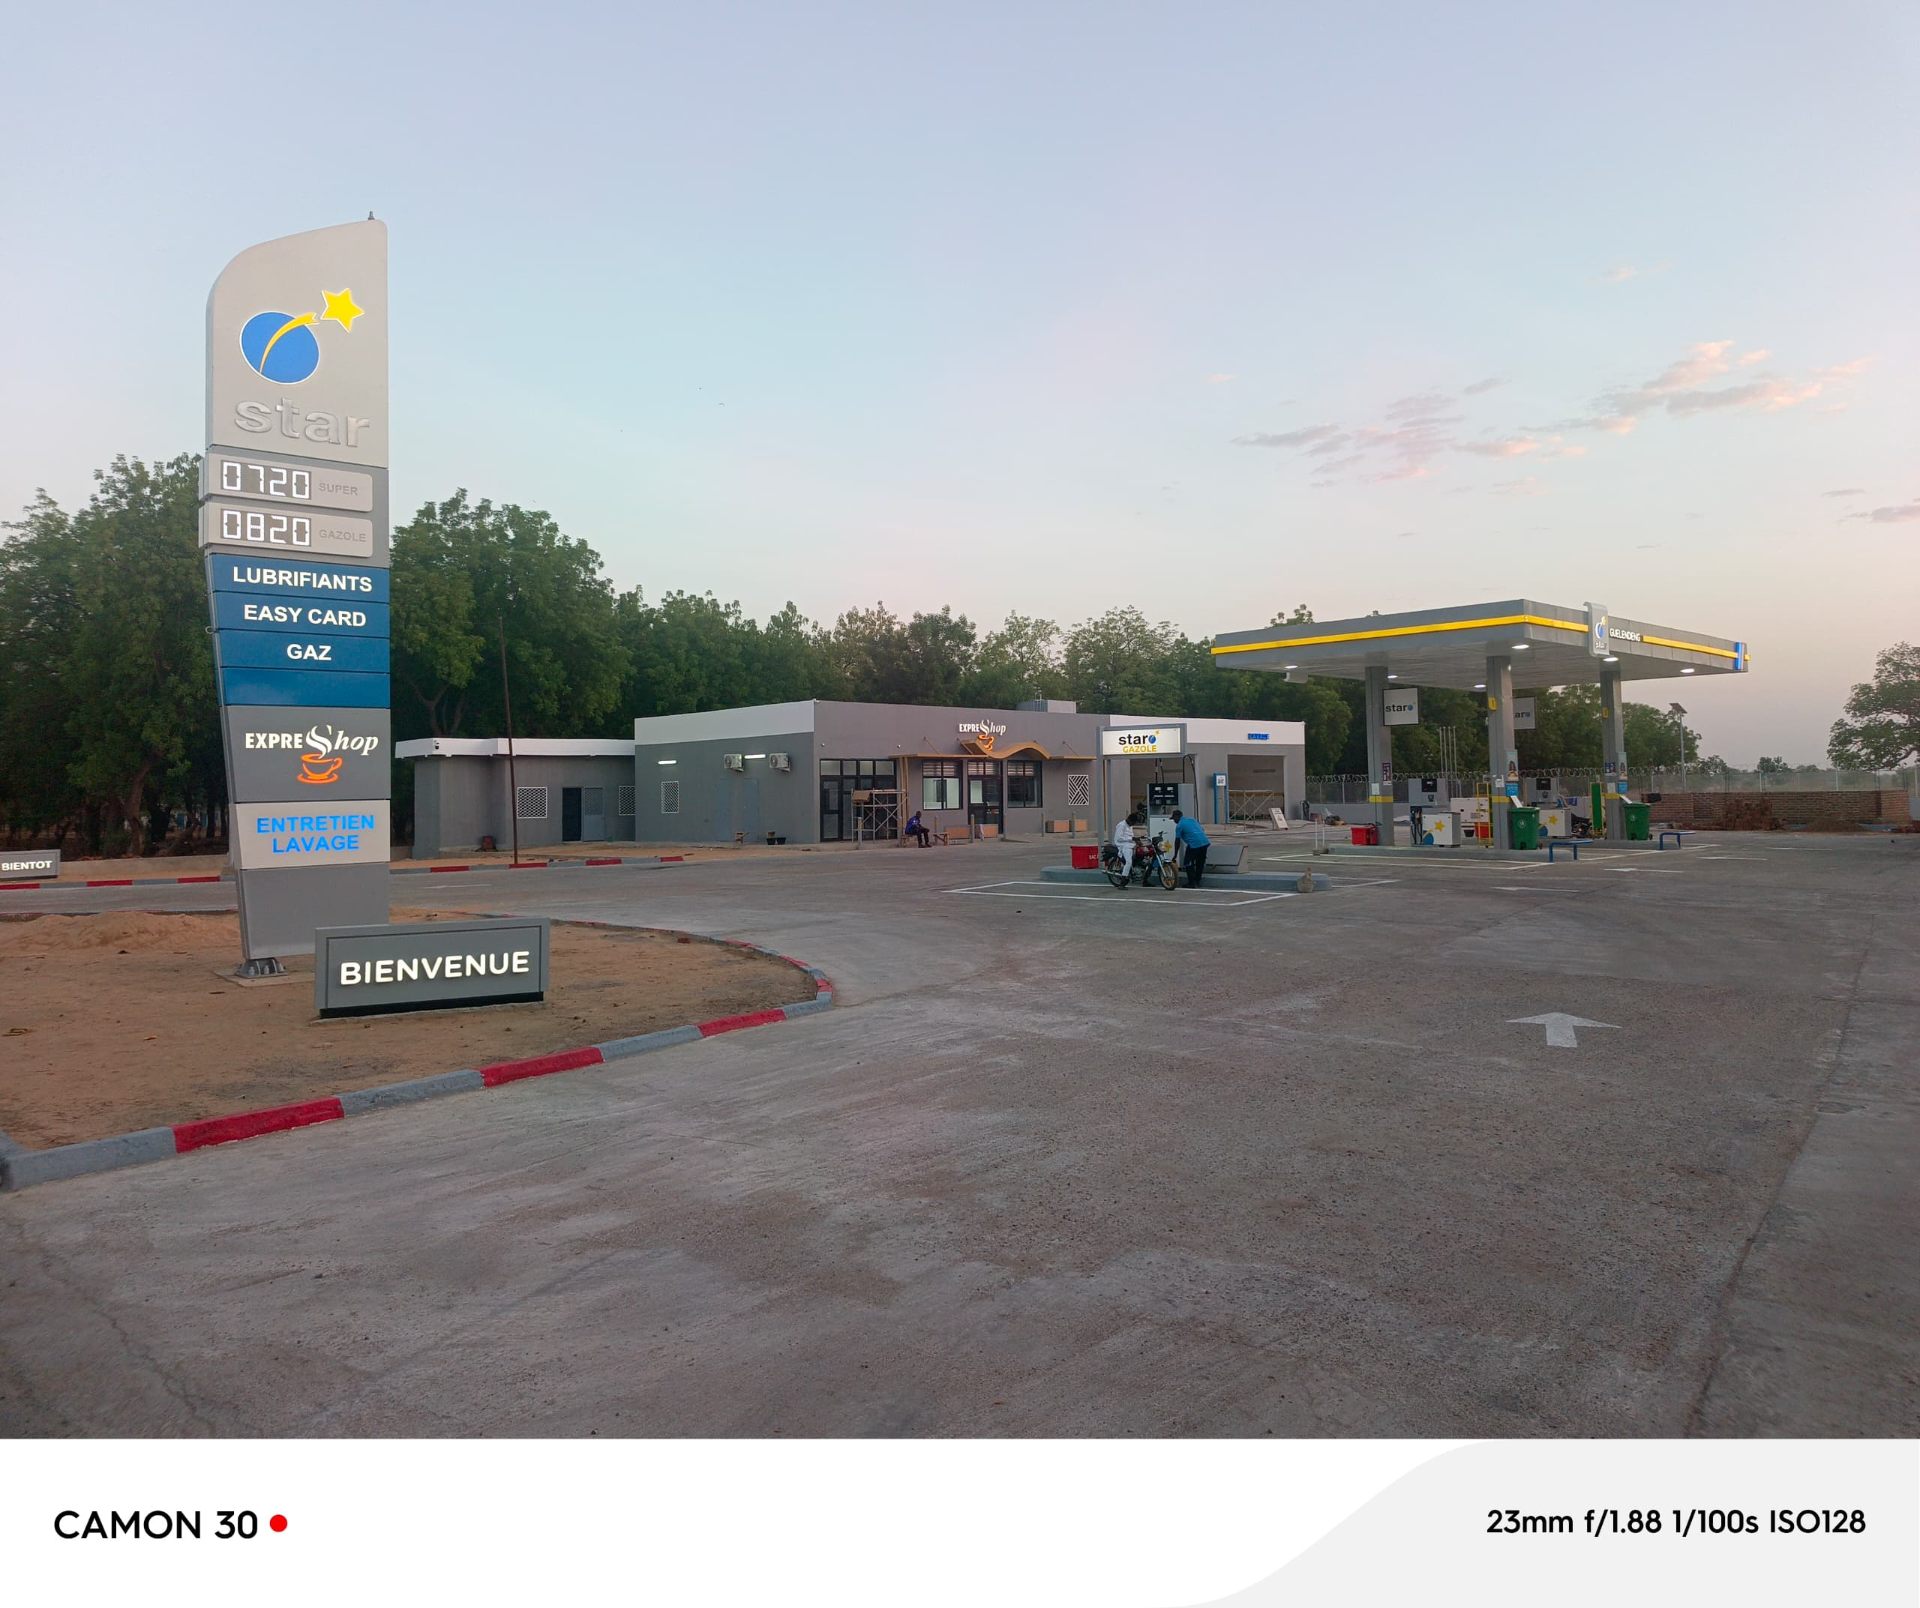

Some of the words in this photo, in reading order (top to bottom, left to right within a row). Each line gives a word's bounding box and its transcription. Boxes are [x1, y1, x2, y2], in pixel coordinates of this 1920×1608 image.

[234, 397, 370, 447] star
[223, 461, 310, 499] 0720
[319, 482, 359, 496] SUPER
[223, 510, 310, 546] 0820
[319, 529, 367, 542] GAZOLE
[233, 566, 373, 592] LUBRIFIANTS
[244, 604, 302, 623] EASY
[307, 608, 367, 627] CARD
[286, 643, 332, 661] GAZ
[1385, 704, 1407, 712] star
[1118, 734, 1148, 745] star
[1122, 745, 1157, 753] GAZOLE
[256, 815, 375, 834] ENTRETIEN
[272, 835, 360, 854] LAVAGE
[1, 860, 53, 871] BIENTOT
[340, 951, 530, 985] BIENVENUE
